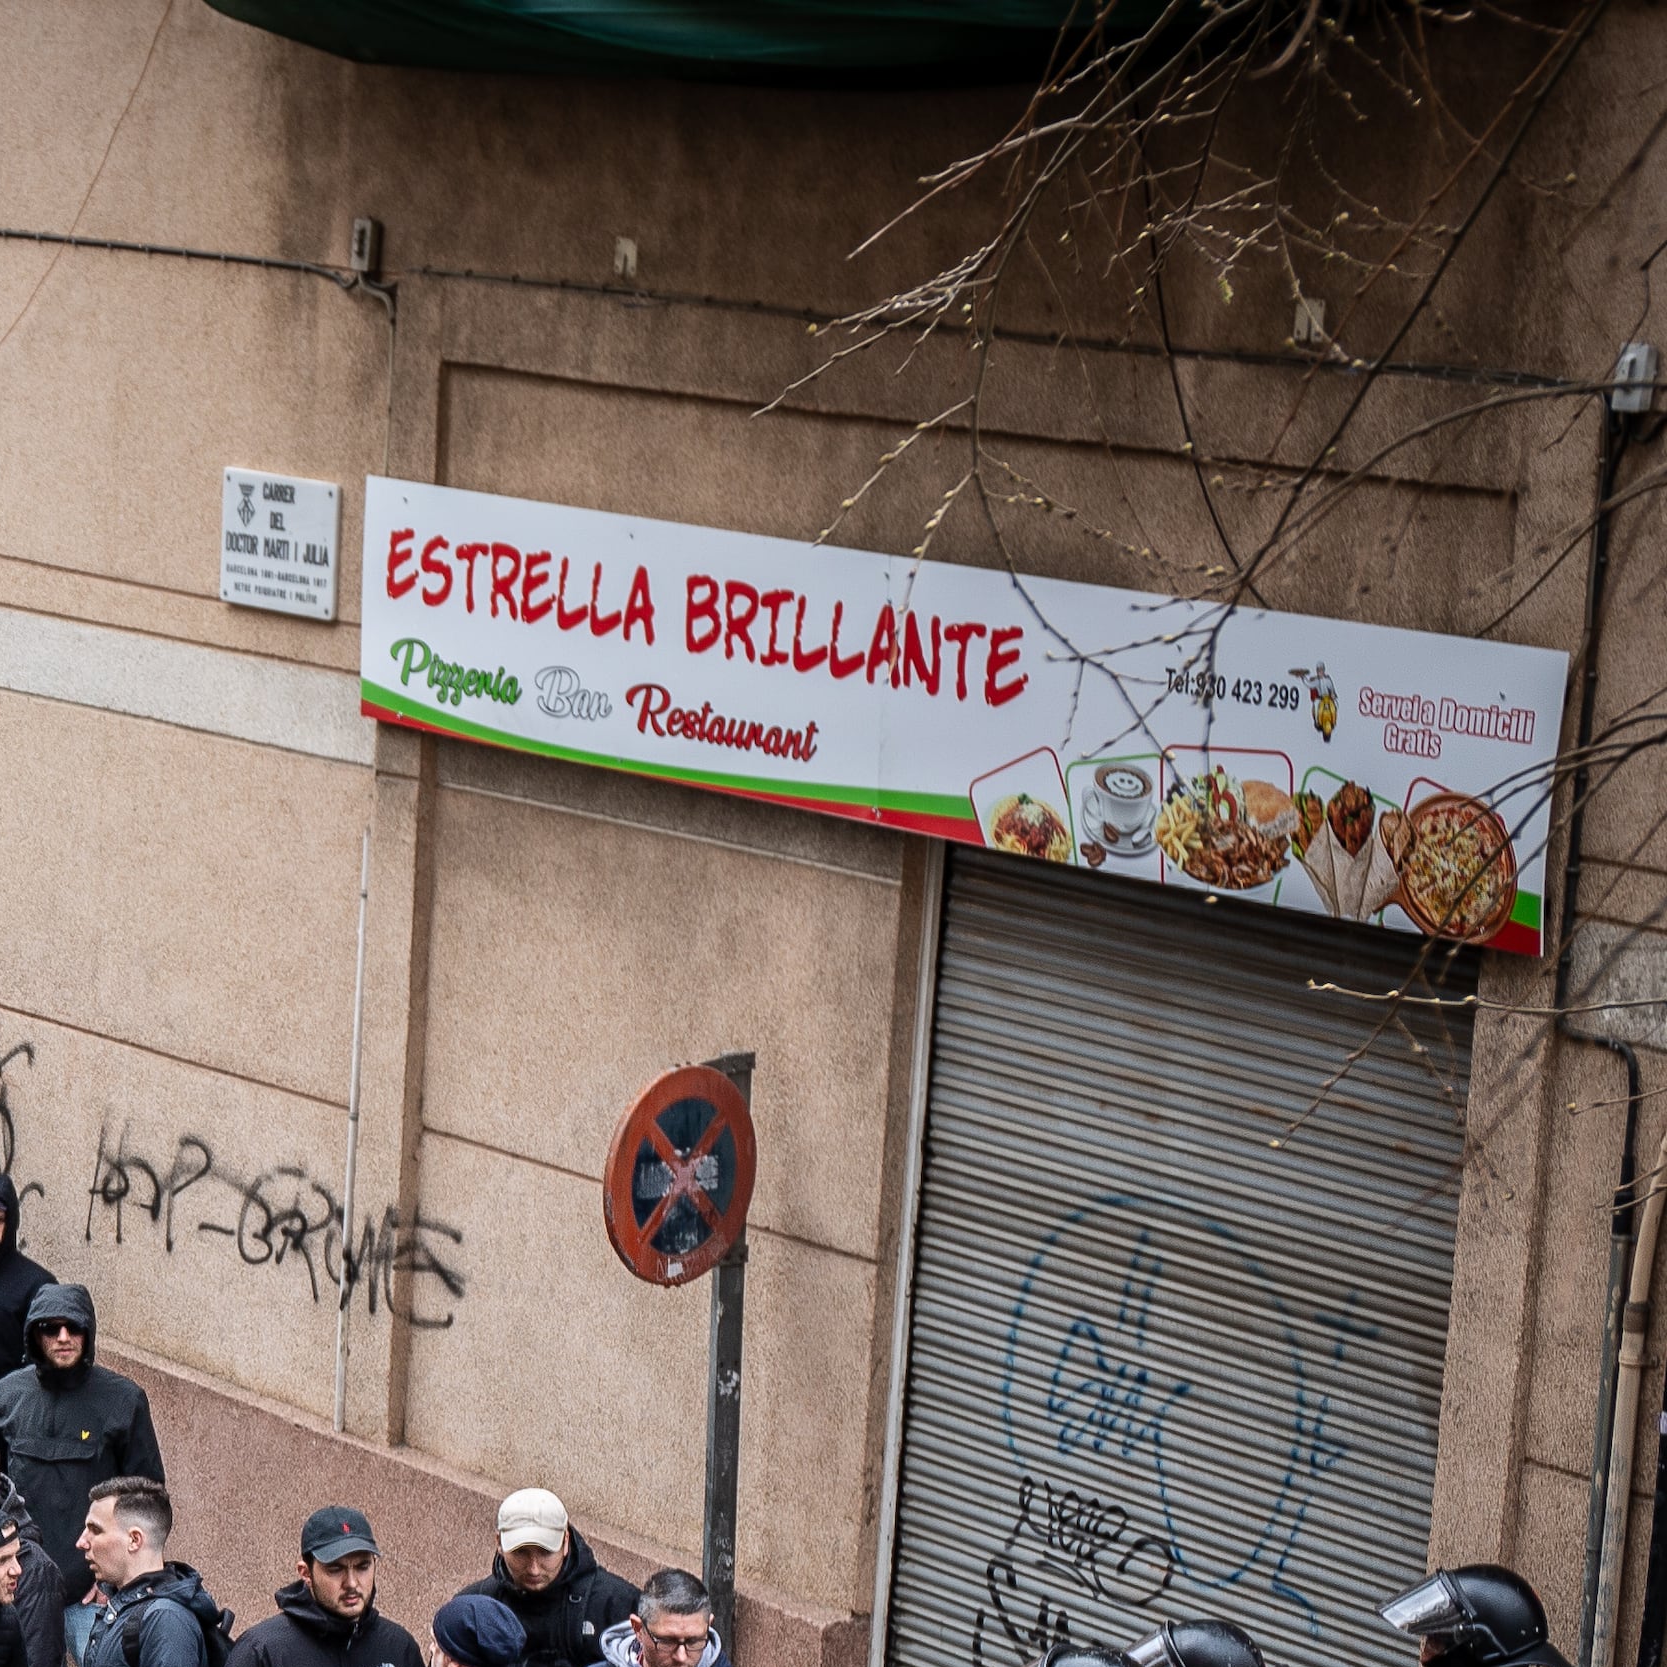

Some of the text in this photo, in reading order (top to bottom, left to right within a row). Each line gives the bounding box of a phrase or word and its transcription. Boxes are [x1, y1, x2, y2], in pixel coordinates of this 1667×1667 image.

[262, 482, 296, 505] CARRER
[269, 510, 286, 532] DEL
[225, 530, 259, 556] DOCTOR
[225, 563, 258, 577] BARCELONA
[386, 529, 1030, 707] ESTRELLA BRILLANTE
[390, 637, 821, 763] Pizzeria Bar Restaurant
[1231, 675, 1264, 706] 423
[1268, 684, 1300, 711] 299
[1358, 686, 1423, 723] Servei
[1438, 697, 1536, 745] Domicili
[1383, 723, 1443, 759] Gratis
